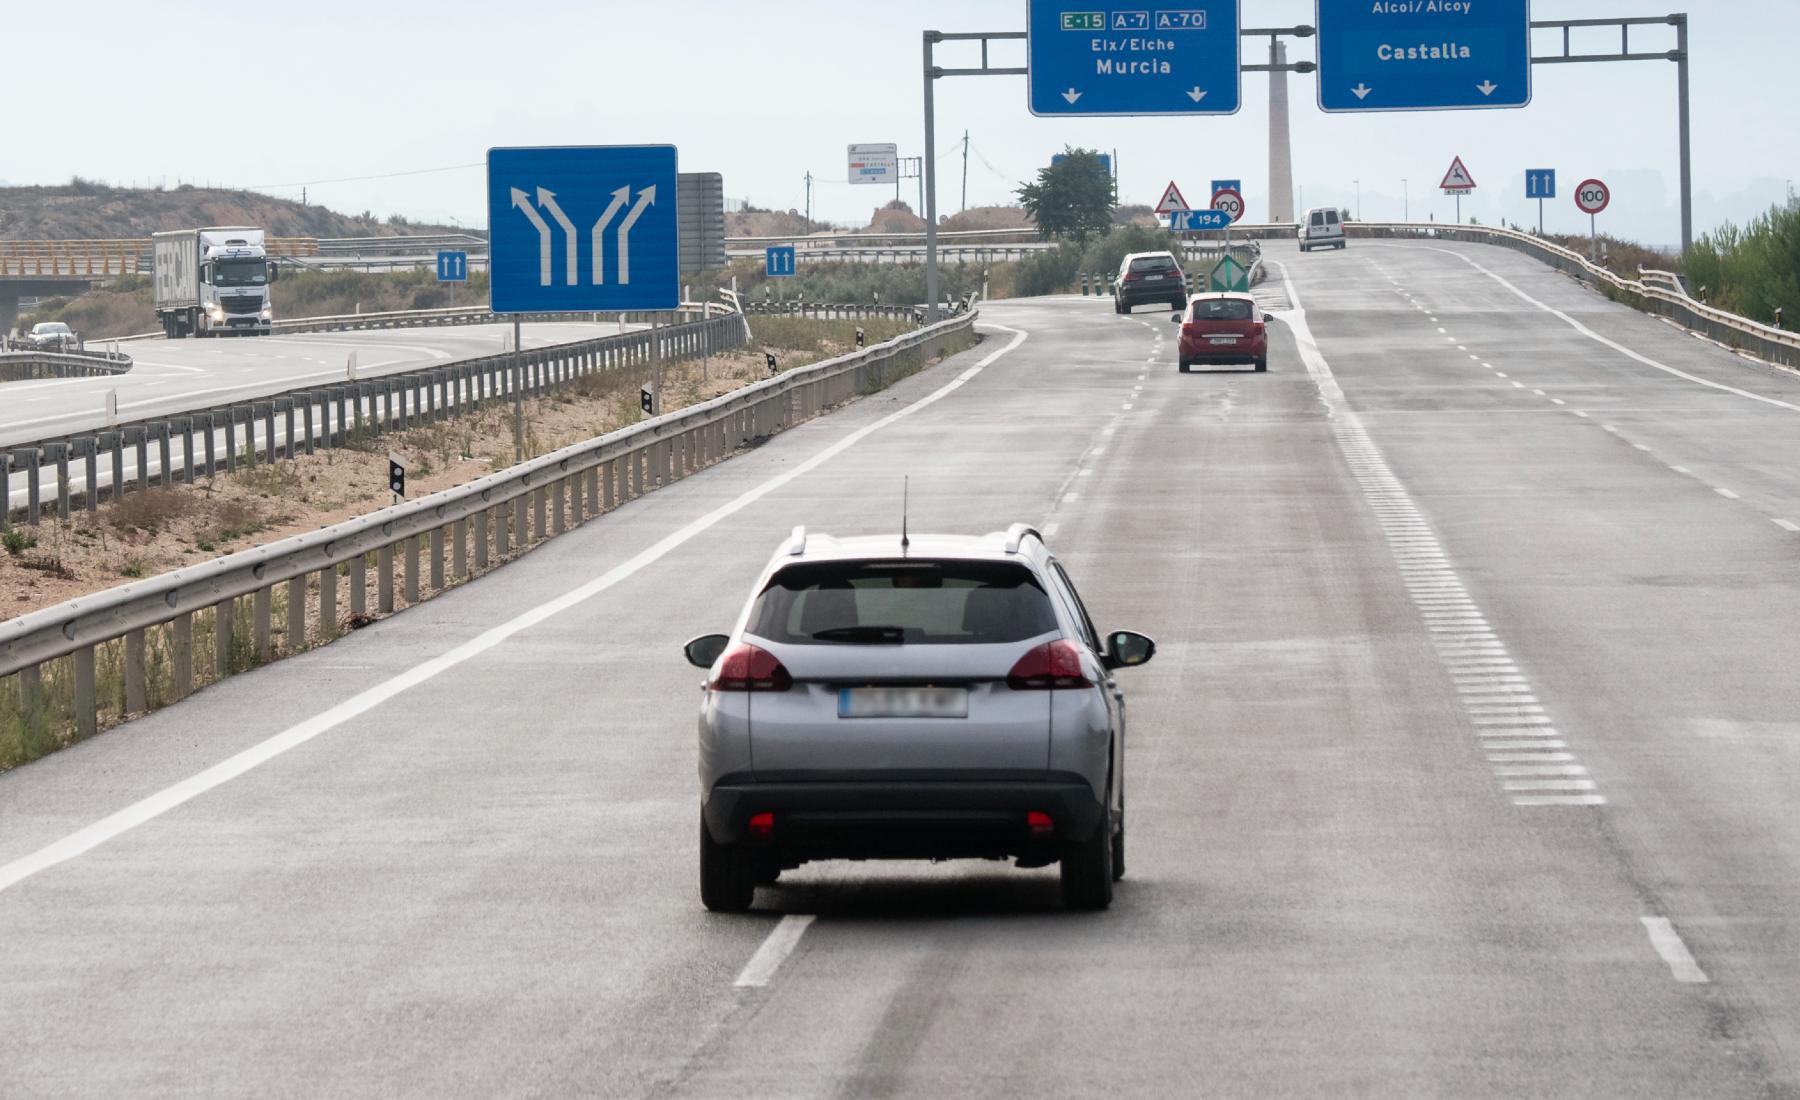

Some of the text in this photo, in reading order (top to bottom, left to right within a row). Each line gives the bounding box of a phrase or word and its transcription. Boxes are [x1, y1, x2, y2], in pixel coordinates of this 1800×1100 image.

[1372, 0, 1471, 15] Alcoi/Alcoy
[1063, 13, 1203, 28] E-15 A-7 A-70
[1091, 38, 1176, 51] Elx/Elche
[1377, 42, 1471, 61] Castalla
[1096, 58, 1171, 75] Murcia
[1580, 190, 1605, 203] 100
[1216, 201, 1239, 212] 100
[1199, 215, 1221, 225] 194
